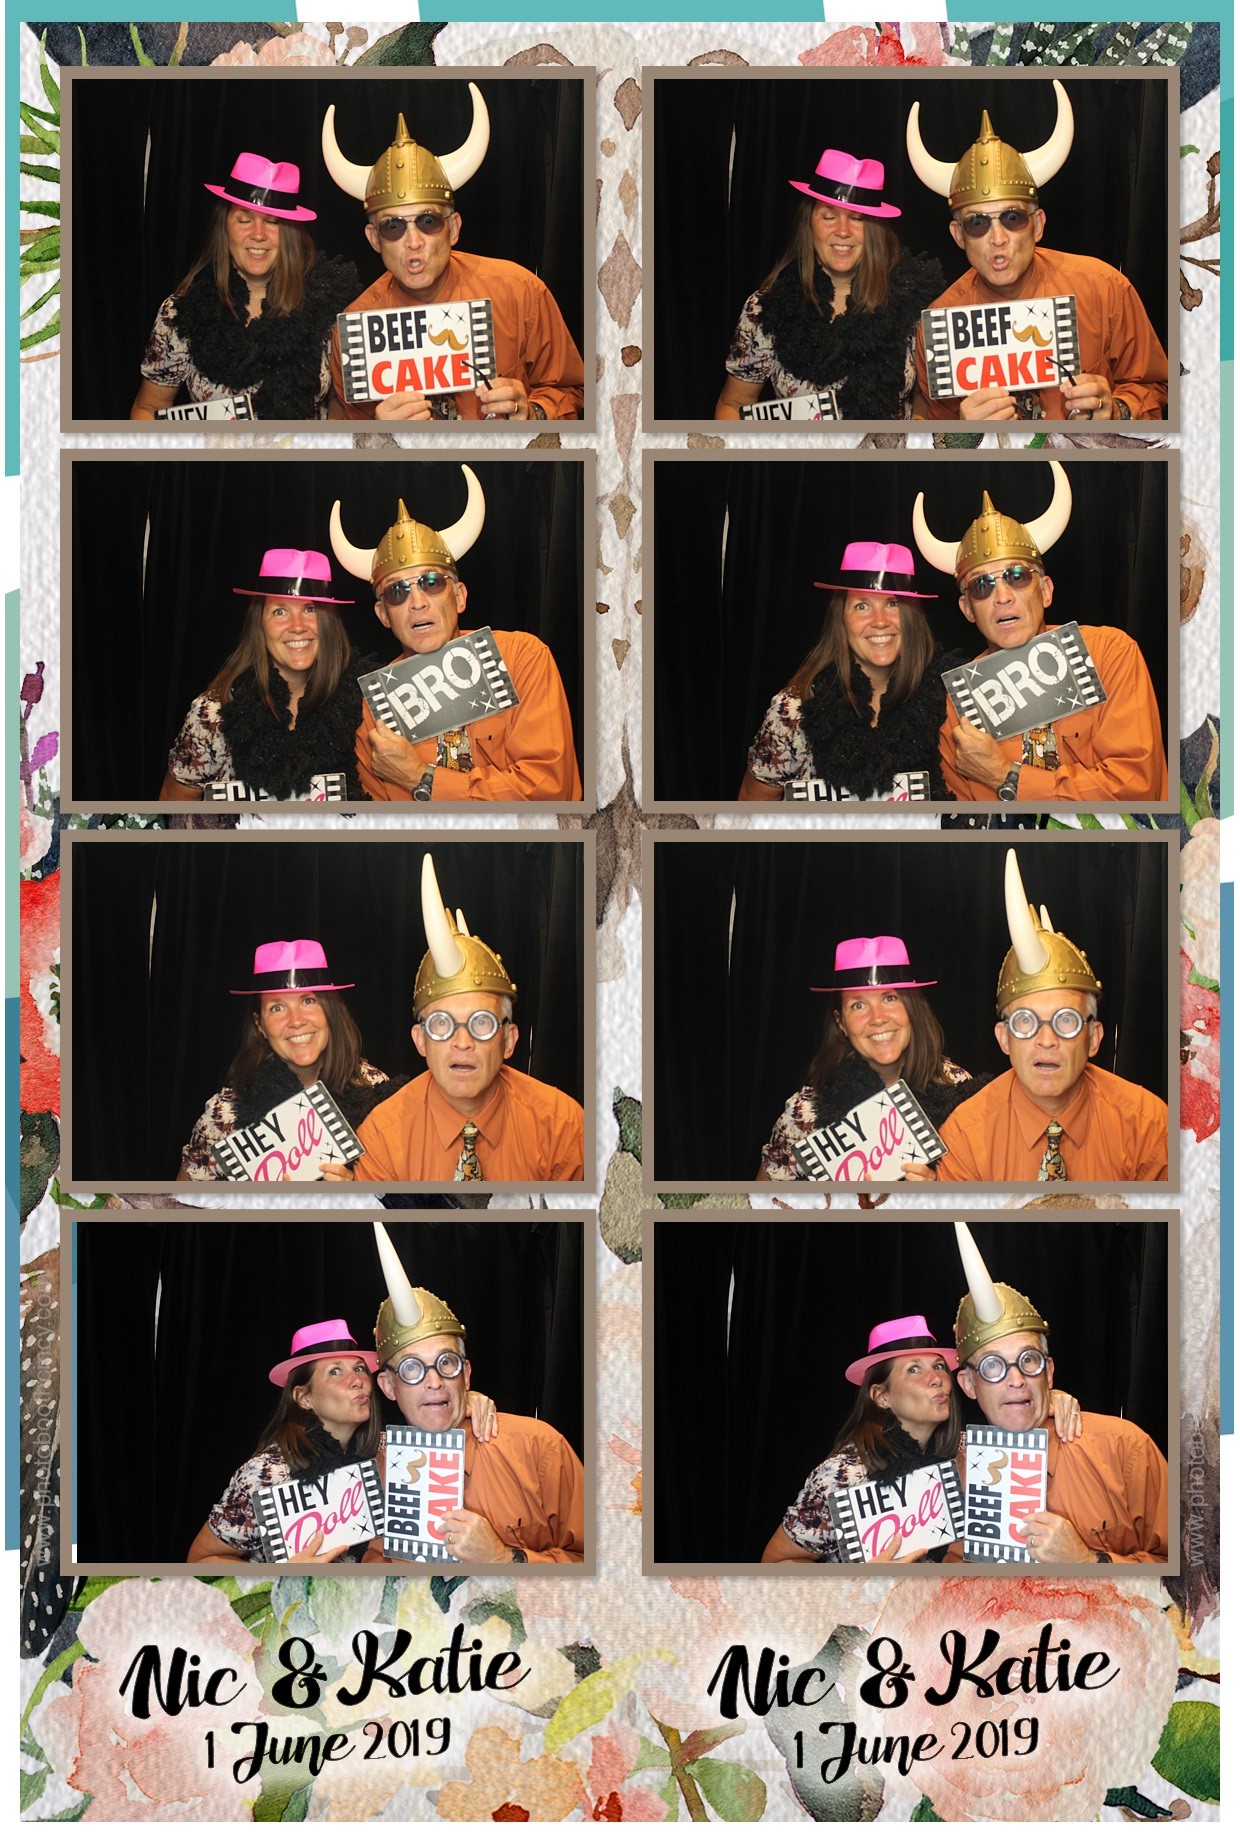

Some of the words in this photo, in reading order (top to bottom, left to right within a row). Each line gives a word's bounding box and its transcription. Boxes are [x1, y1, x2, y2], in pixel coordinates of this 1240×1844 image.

[367, 308, 427, 353] BEEF
[952, 306, 1012, 350] BEEF
[371, 352, 472, 395] CAKE
[956, 349, 1056, 391] CAKE
[387, 646, 482, 730] BRO
[972, 641, 1068, 728] BRO
[232, 1112, 286, 1163] HEY
[254, 1107, 323, 1181] Doll
[812, 1111, 868, 1162] HEY
[835, 1106, 905, 1181] Doll
[277, 1475, 330, 1517] HEY
[285, 1480, 365, 1554] Doll
[387, 1481, 421, 1537] BEEF
[426, 1451, 460, 1541] CAKE
[854, 1476, 908, 1519] HEY
[861, 1481, 944, 1557] Doll
[967, 1483, 1002, 1539] BEEF
[1008, 1451, 1043, 1546] CAKE
